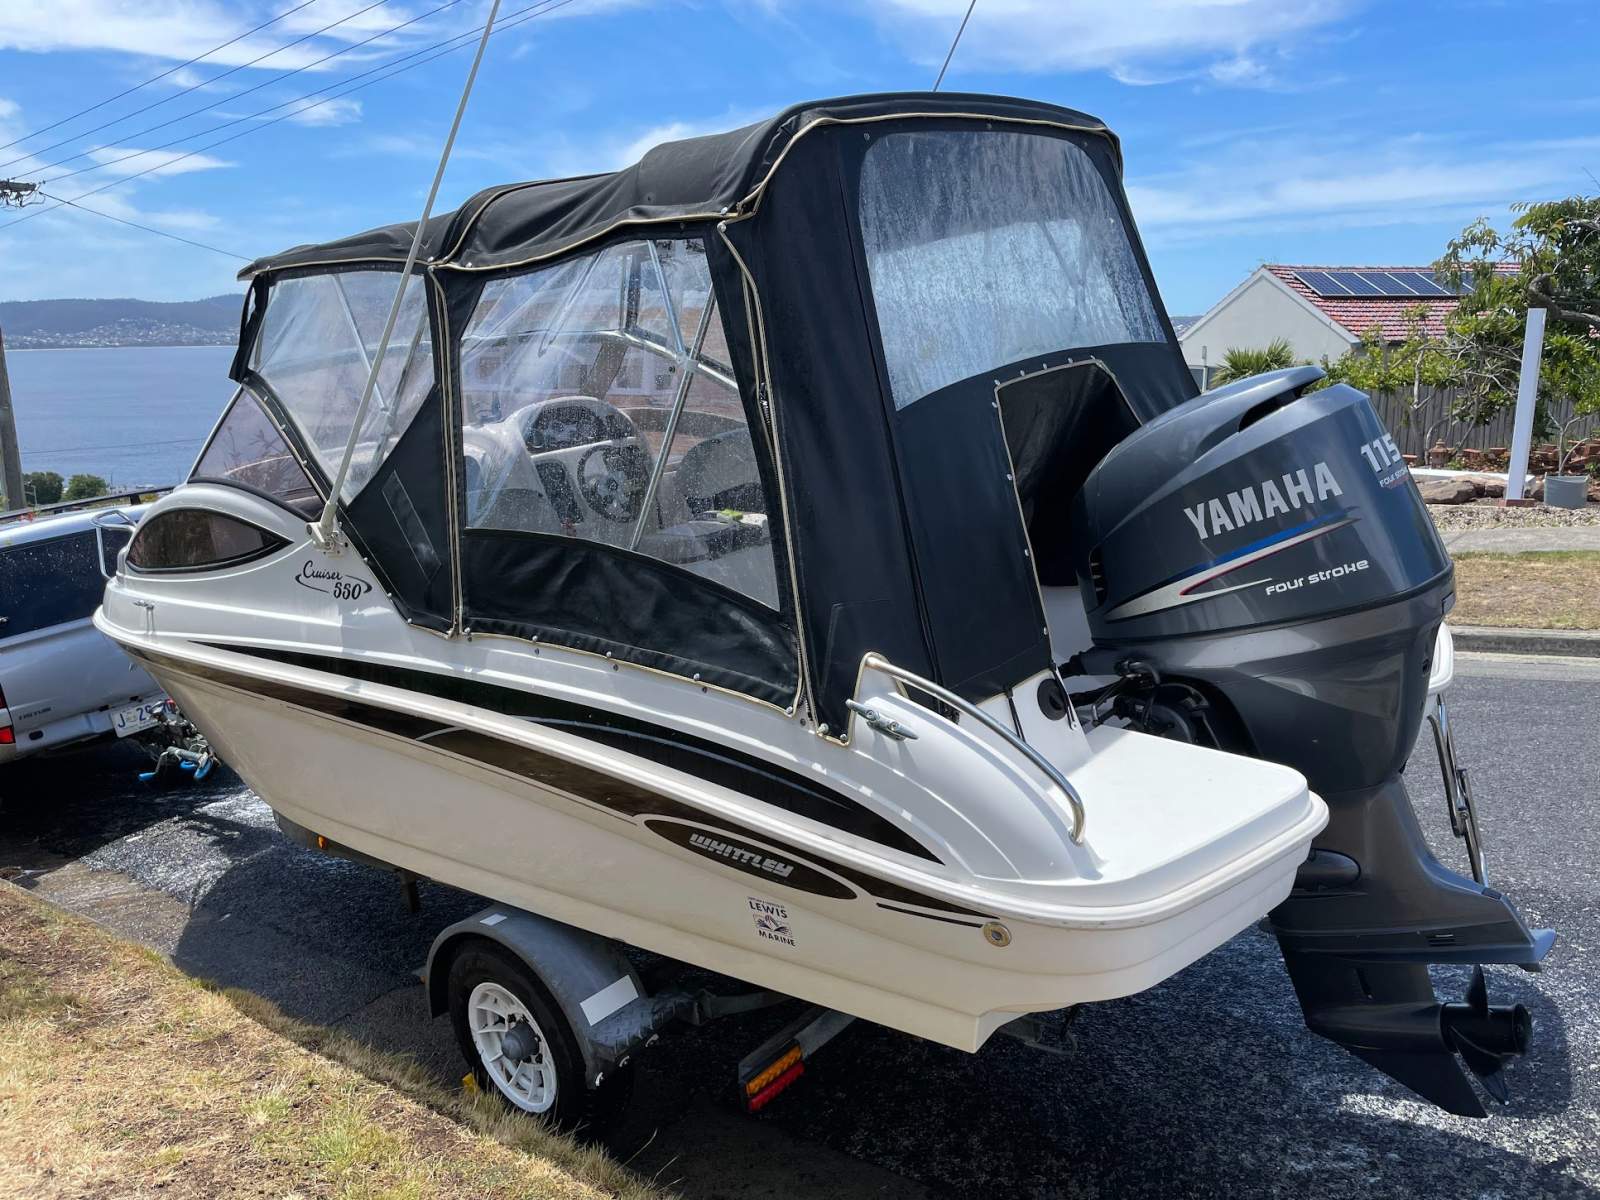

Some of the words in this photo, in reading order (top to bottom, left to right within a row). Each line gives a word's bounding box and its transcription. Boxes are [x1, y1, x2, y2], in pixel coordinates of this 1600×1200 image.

[1361, 432, 1401, 473] 115
[1184, 462, 1343, 540] YAMAHA
[303, 560, 343, 580] Cruiser
[333, 582, 362, 600] 550
[749, 900, 788, 919] LEWIS
[758, 929, 796, 947] MARINE
